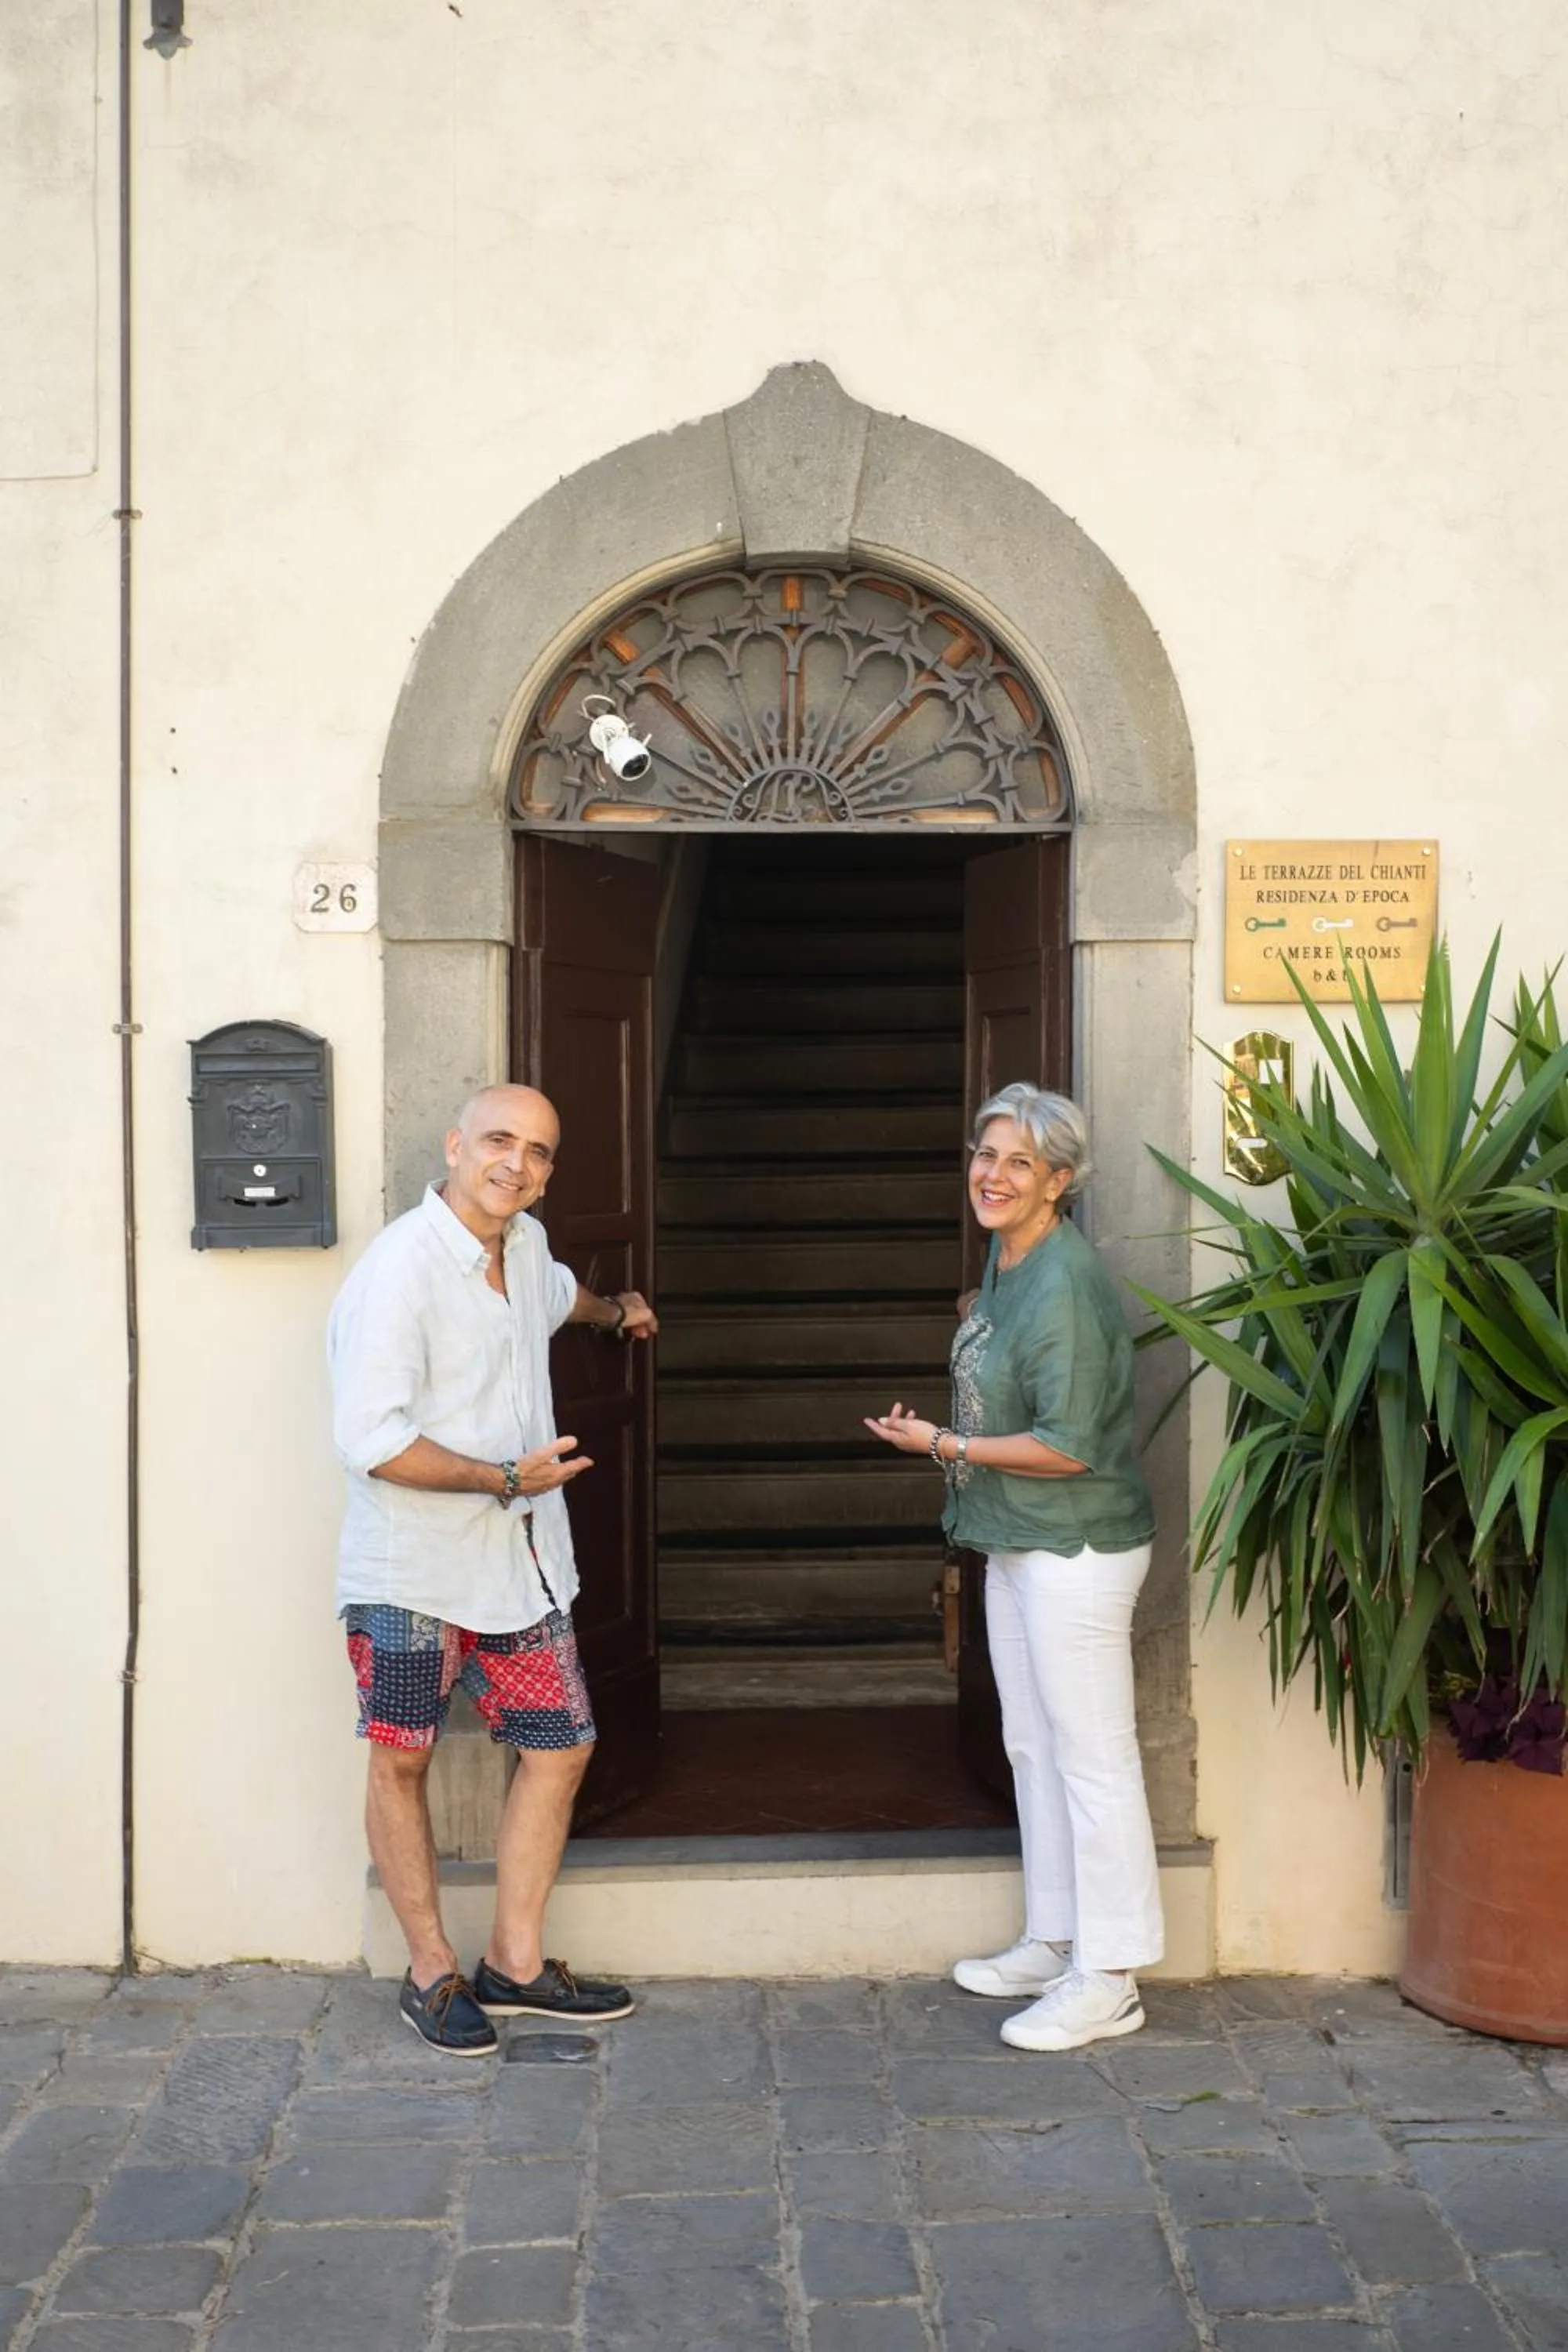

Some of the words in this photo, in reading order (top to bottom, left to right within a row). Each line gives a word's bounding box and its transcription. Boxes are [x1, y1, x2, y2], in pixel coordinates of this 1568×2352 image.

[1240, 865, 1256, 880] LE
[1263, 865, 1333, 880] TERRAZZE
[1339, 865, 1364, 880] DEL
[1370, 865, 1426, 880] CHIANTI
[310, 884, 357, 913] 26
[1256, 890, 1338, 903] RESIDENZA
[1263, 946, 1334, 960] CAMERE
[1344, 946, 1401, 960] ROOMS
[1313, 969, 1322, 982] b
[1326, 968, 1336, 982] &
